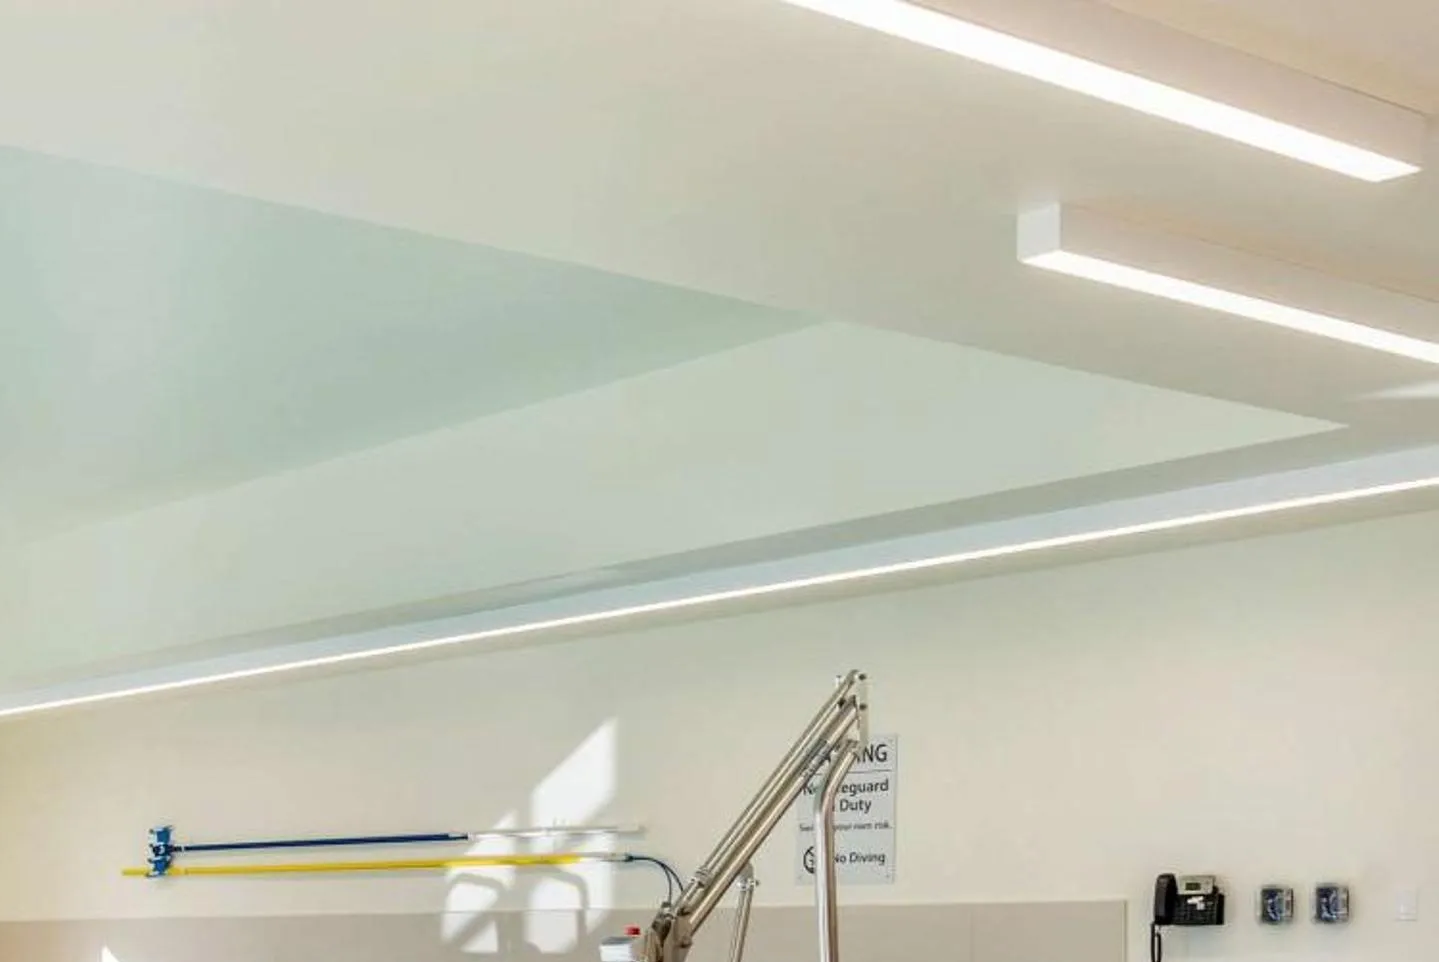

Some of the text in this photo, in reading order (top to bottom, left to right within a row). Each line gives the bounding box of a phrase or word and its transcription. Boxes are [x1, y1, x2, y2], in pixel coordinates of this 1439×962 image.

[840, 778, 889, 796] eguard
[840, 800, 871, 814] Duty
[850, 852, 886, 866] Diving
